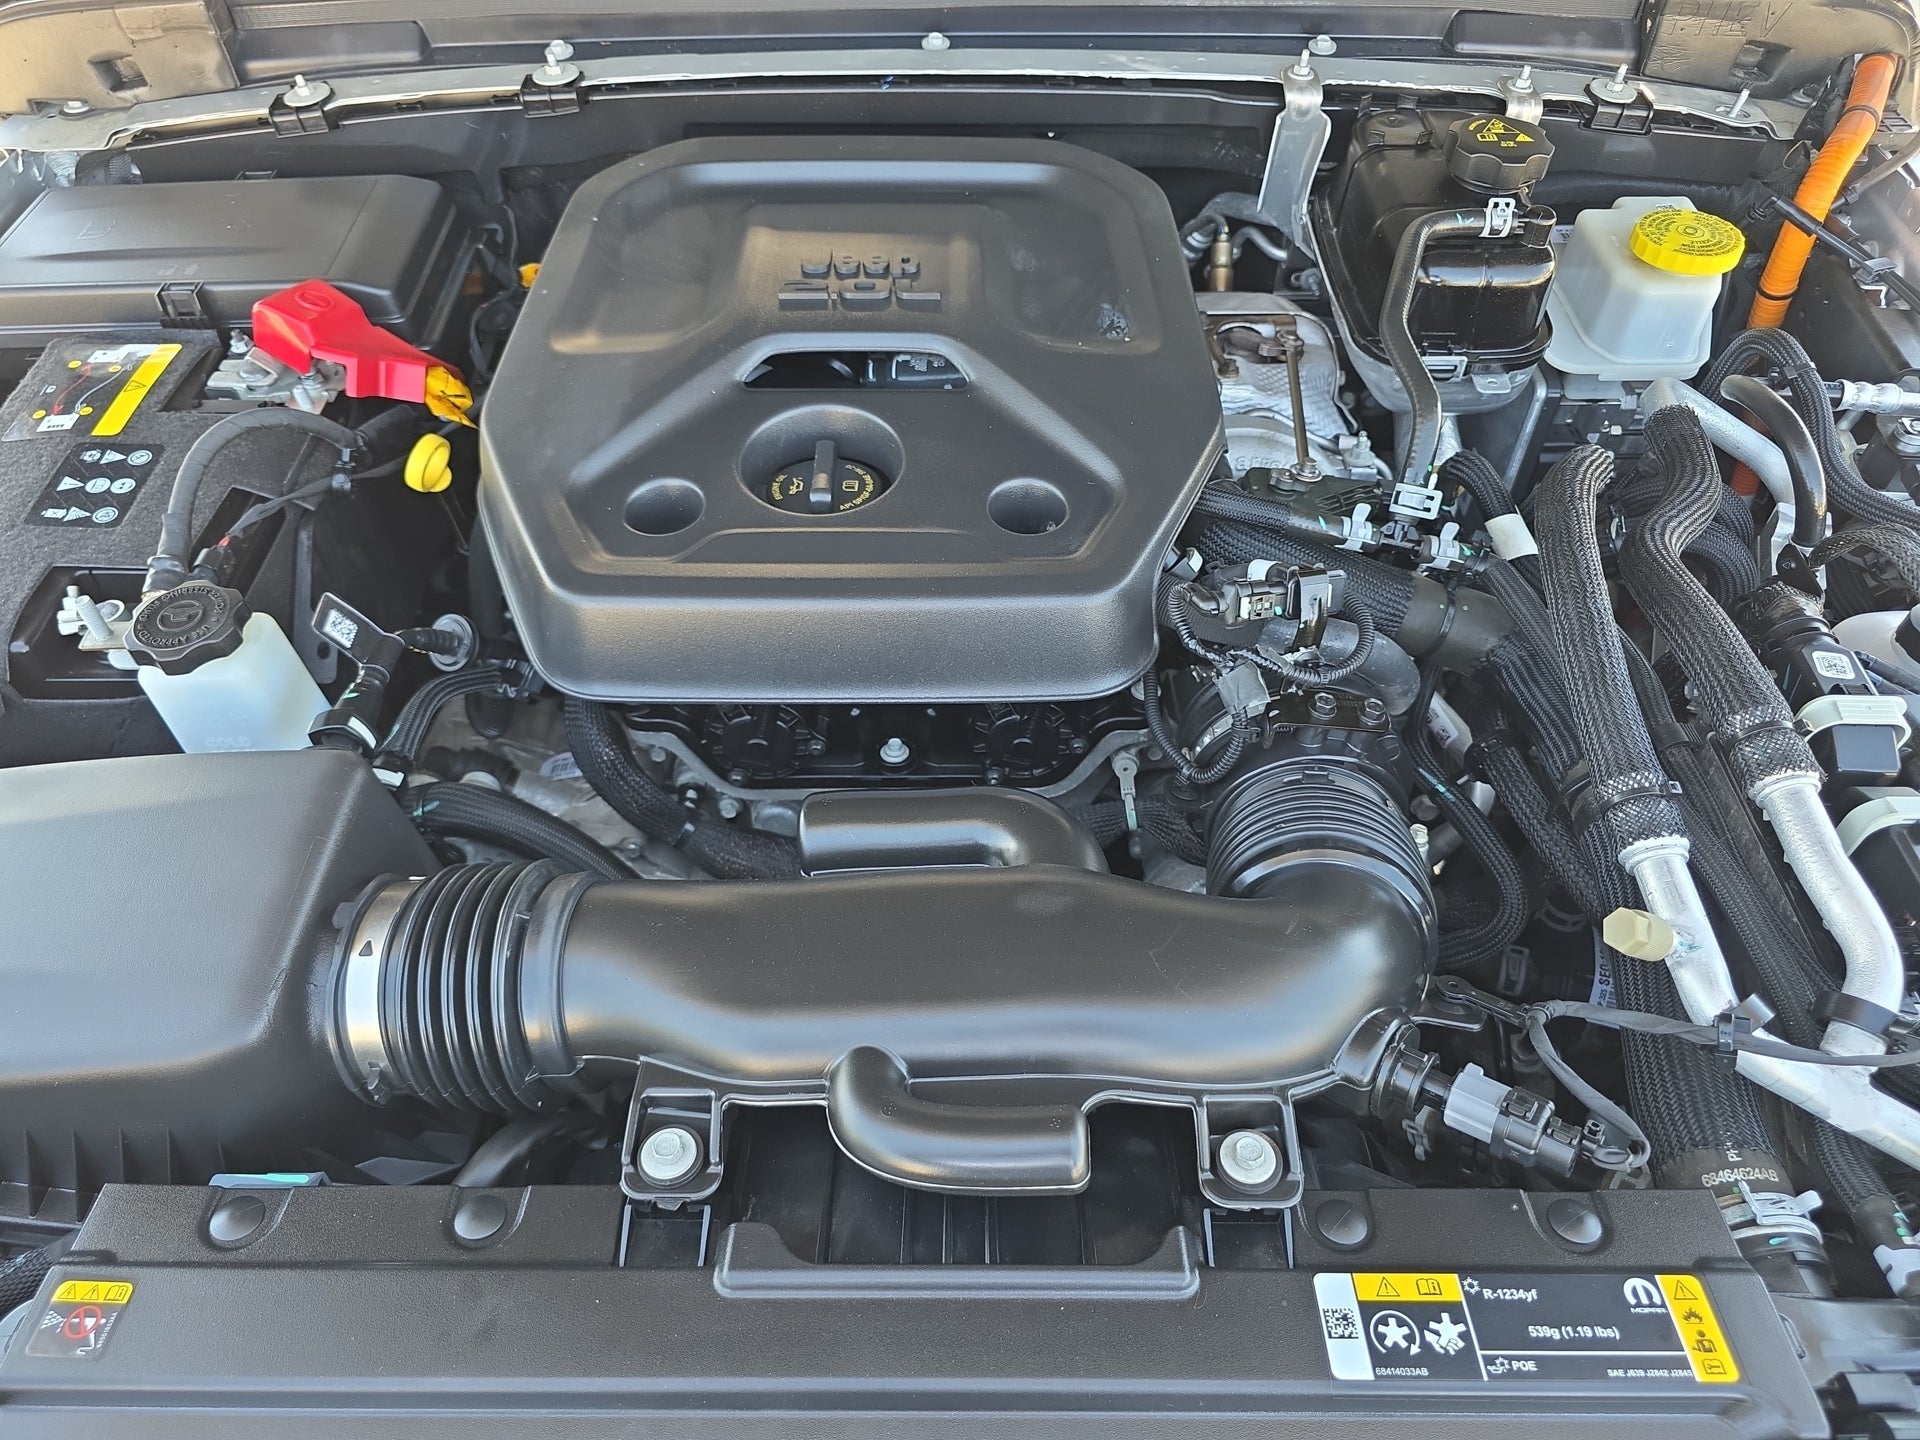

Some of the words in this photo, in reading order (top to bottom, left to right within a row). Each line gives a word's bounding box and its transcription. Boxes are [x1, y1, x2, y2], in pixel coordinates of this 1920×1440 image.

[801, 250, 921, 278] Jeep
[778, 278, 941, 300] 2.0L
[1701, 1167, 1779, 1187] 68464624AB
[1483, 1288, 1538, 1302] R-1234yf
[1528, 1325, 1561, 1340] 539g
[1562, 1325, 1593, 1340] (1.19
[1595, 1325, 1621, 1340] lbs)
[1375, 1366, 1429, 1377] 68414033AB
[1512, 1360, 1538, 1371] POE
[1606, 1368, 1625, 1377] SAE
